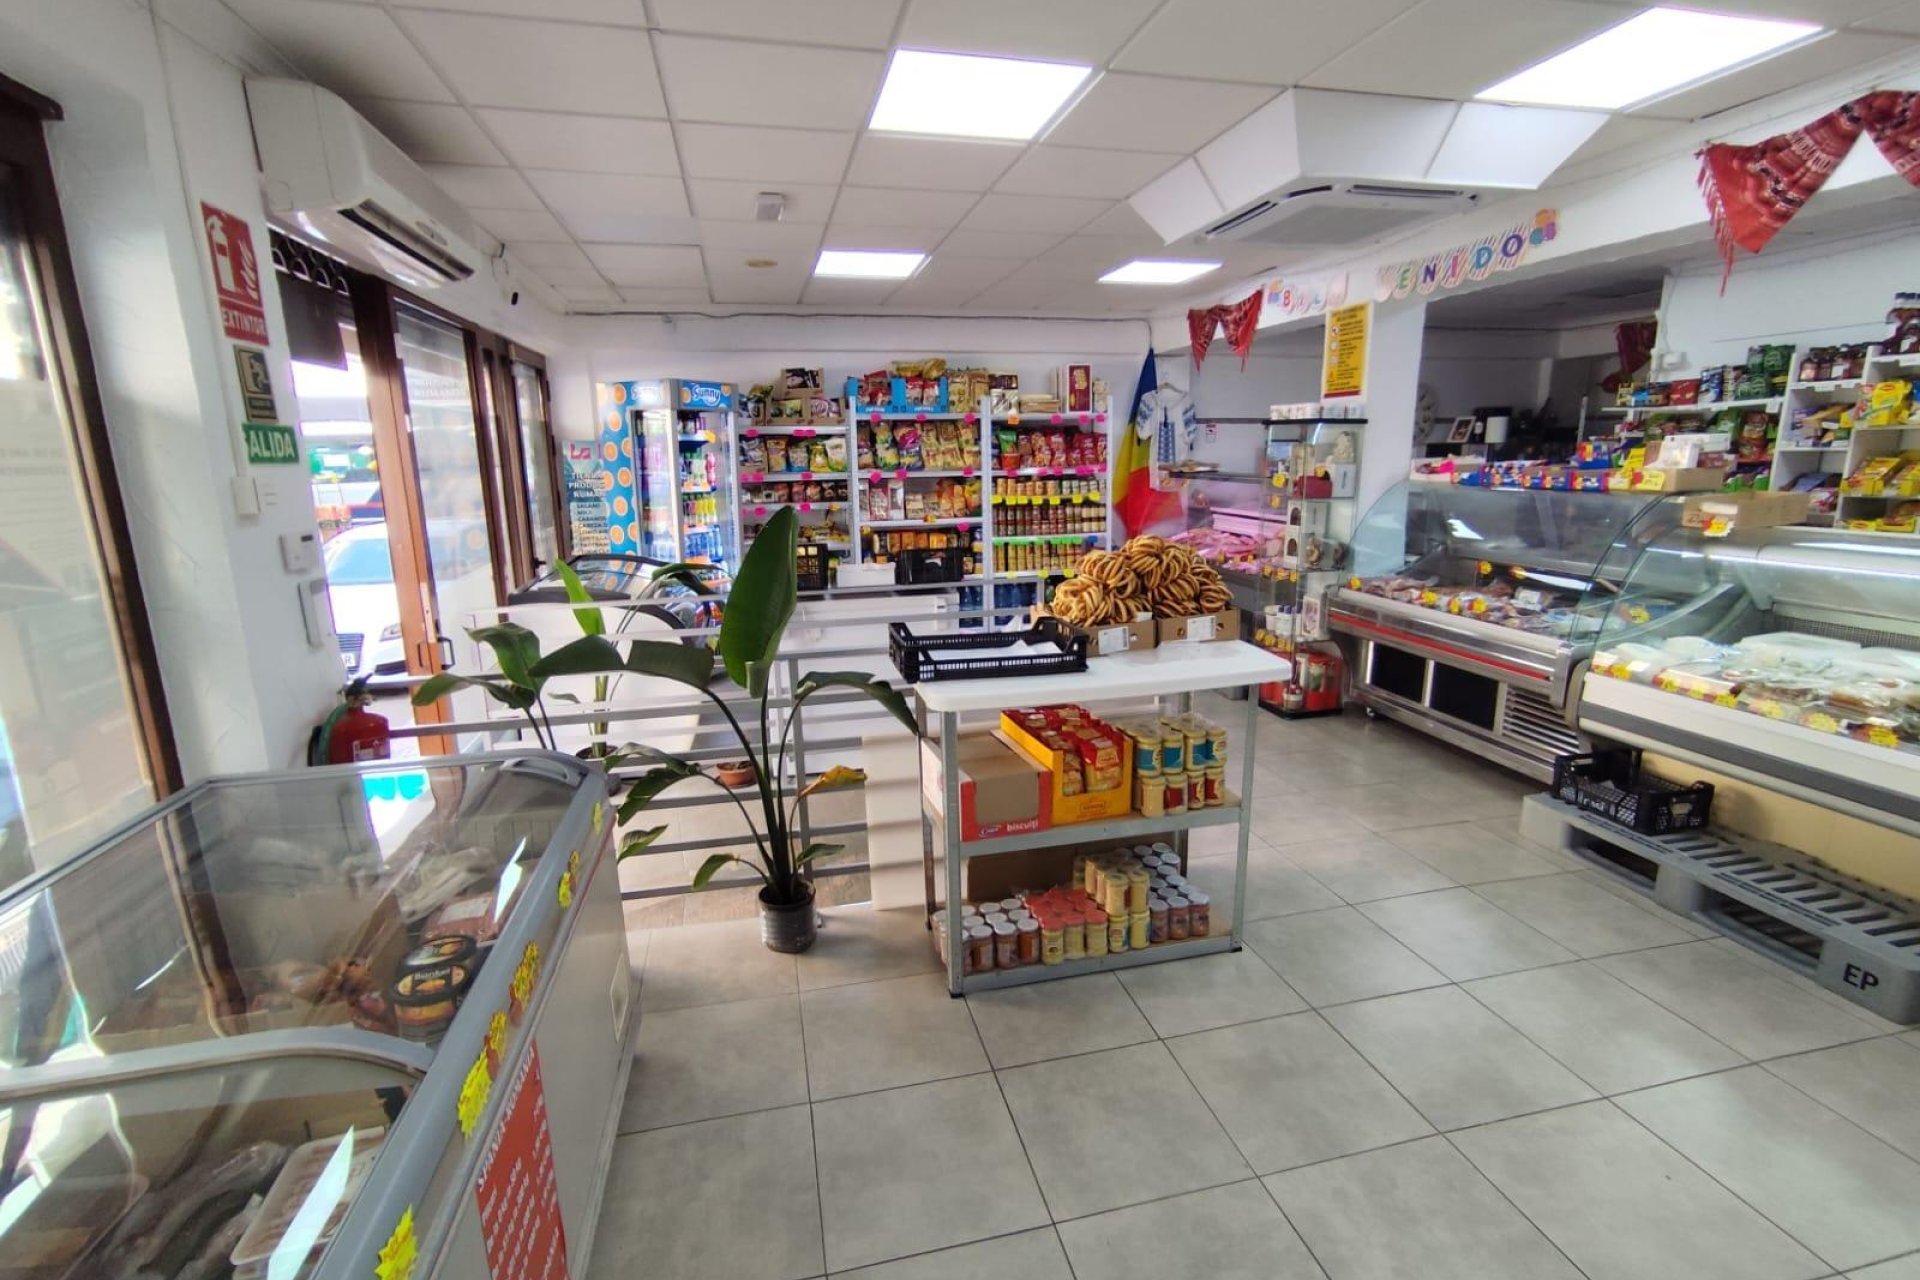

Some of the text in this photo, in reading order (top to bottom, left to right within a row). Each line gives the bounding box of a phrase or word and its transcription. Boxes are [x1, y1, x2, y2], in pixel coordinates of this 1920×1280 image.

[1392, 233, 1523, 290] ENIDO
[222, 309, 267, 335] EXTINTOR
[1842, 962, 1880, 991] EP
